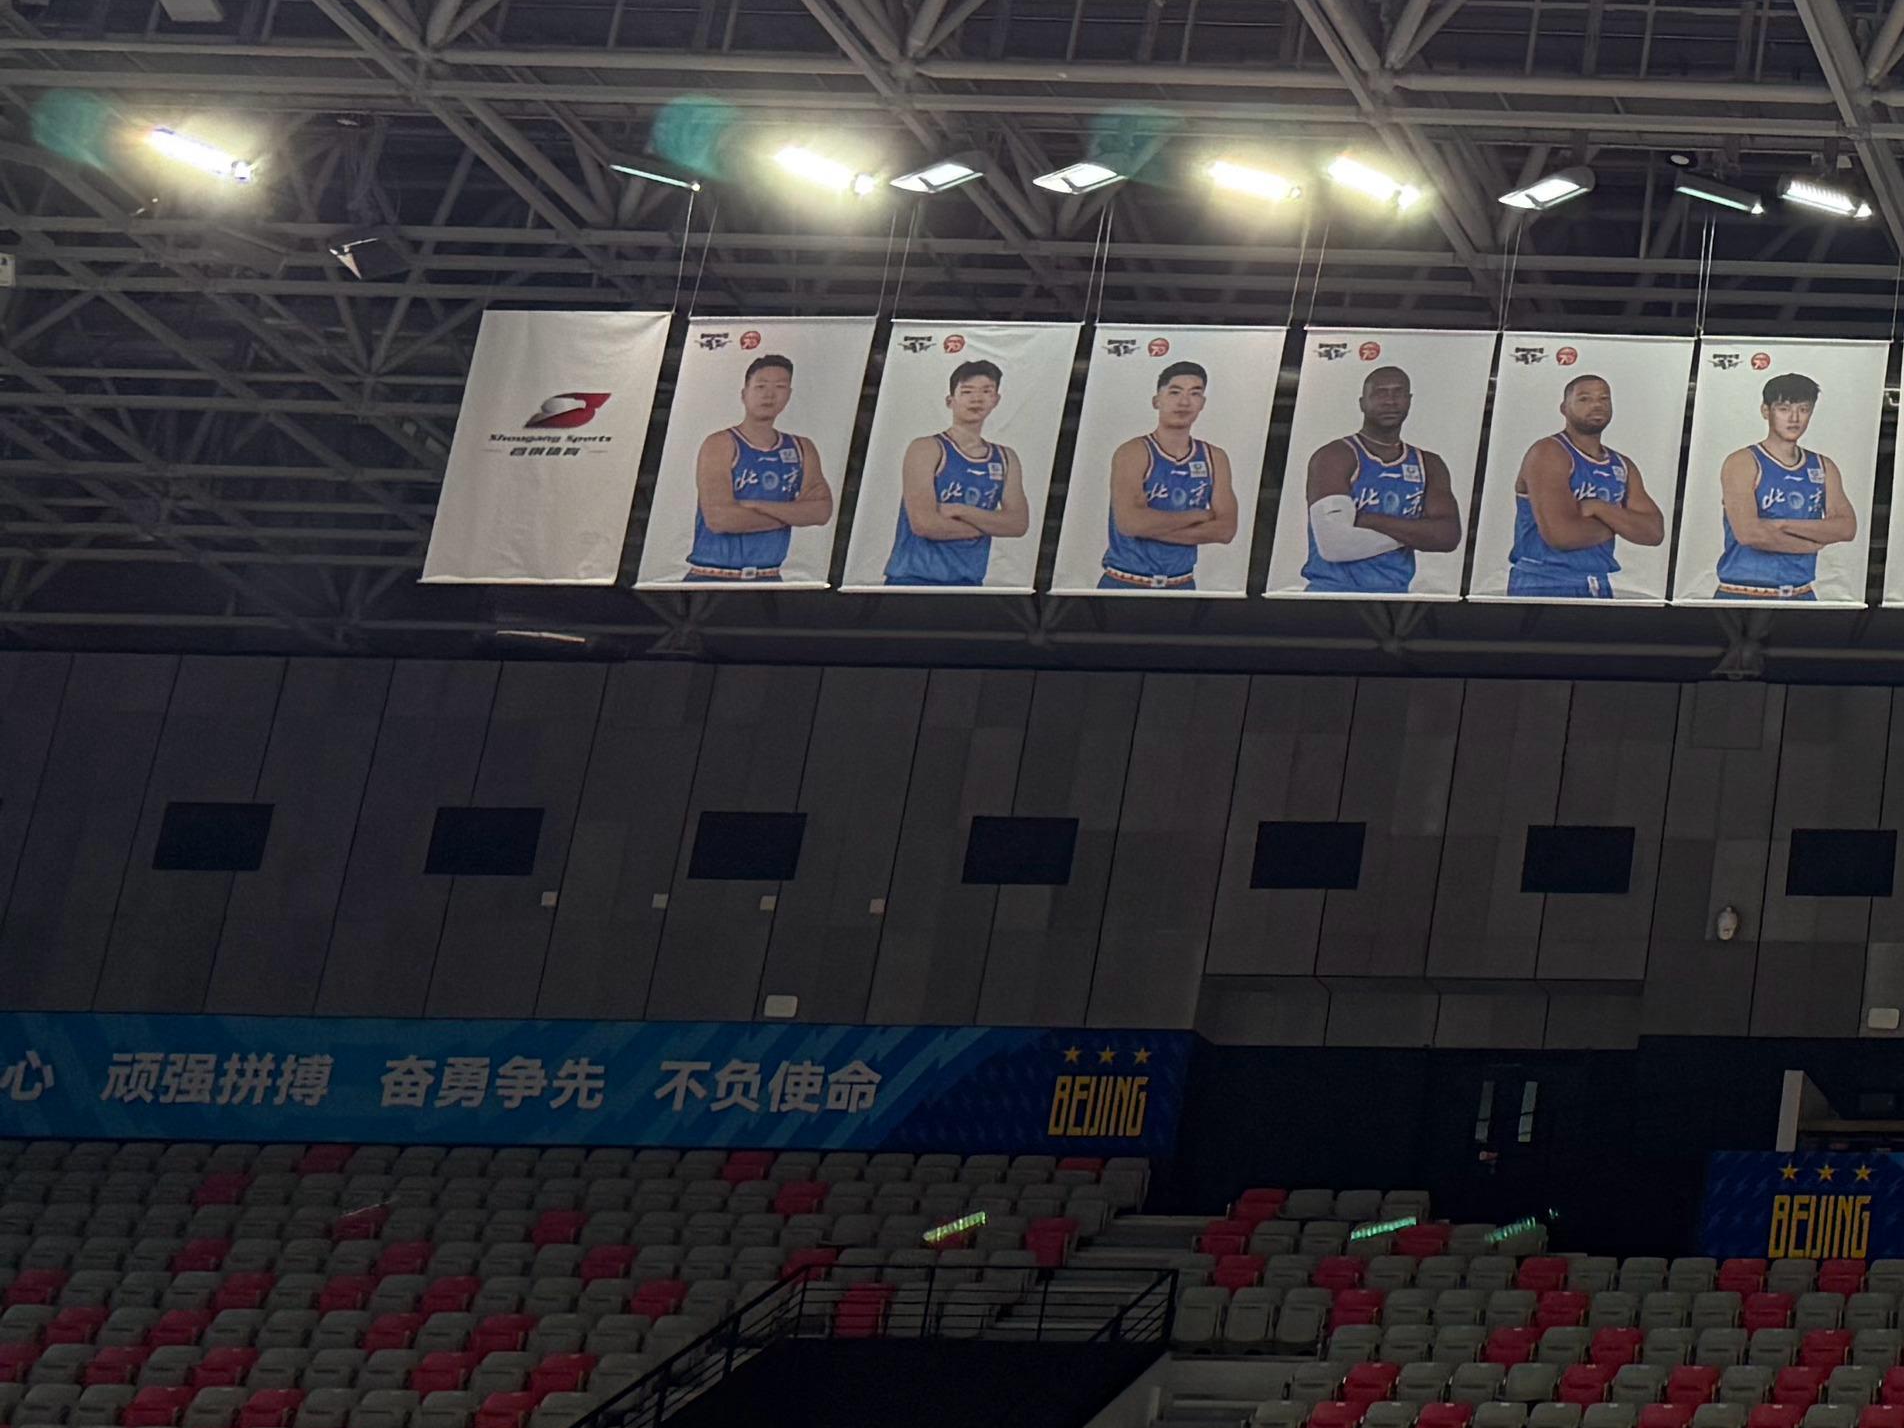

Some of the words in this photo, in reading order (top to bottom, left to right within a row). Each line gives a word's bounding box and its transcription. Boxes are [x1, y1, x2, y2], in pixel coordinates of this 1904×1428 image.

[101, 1052, 334, 1106] 顽强拼搏
[379, 1056, 606, 1110] 奋勇争先
[654, 1060, 882, 1114] 不负使命
[1048, 1075, 1149, 1137] BEIJING
[1768, 1194, 1872, 1260] BEIJING
